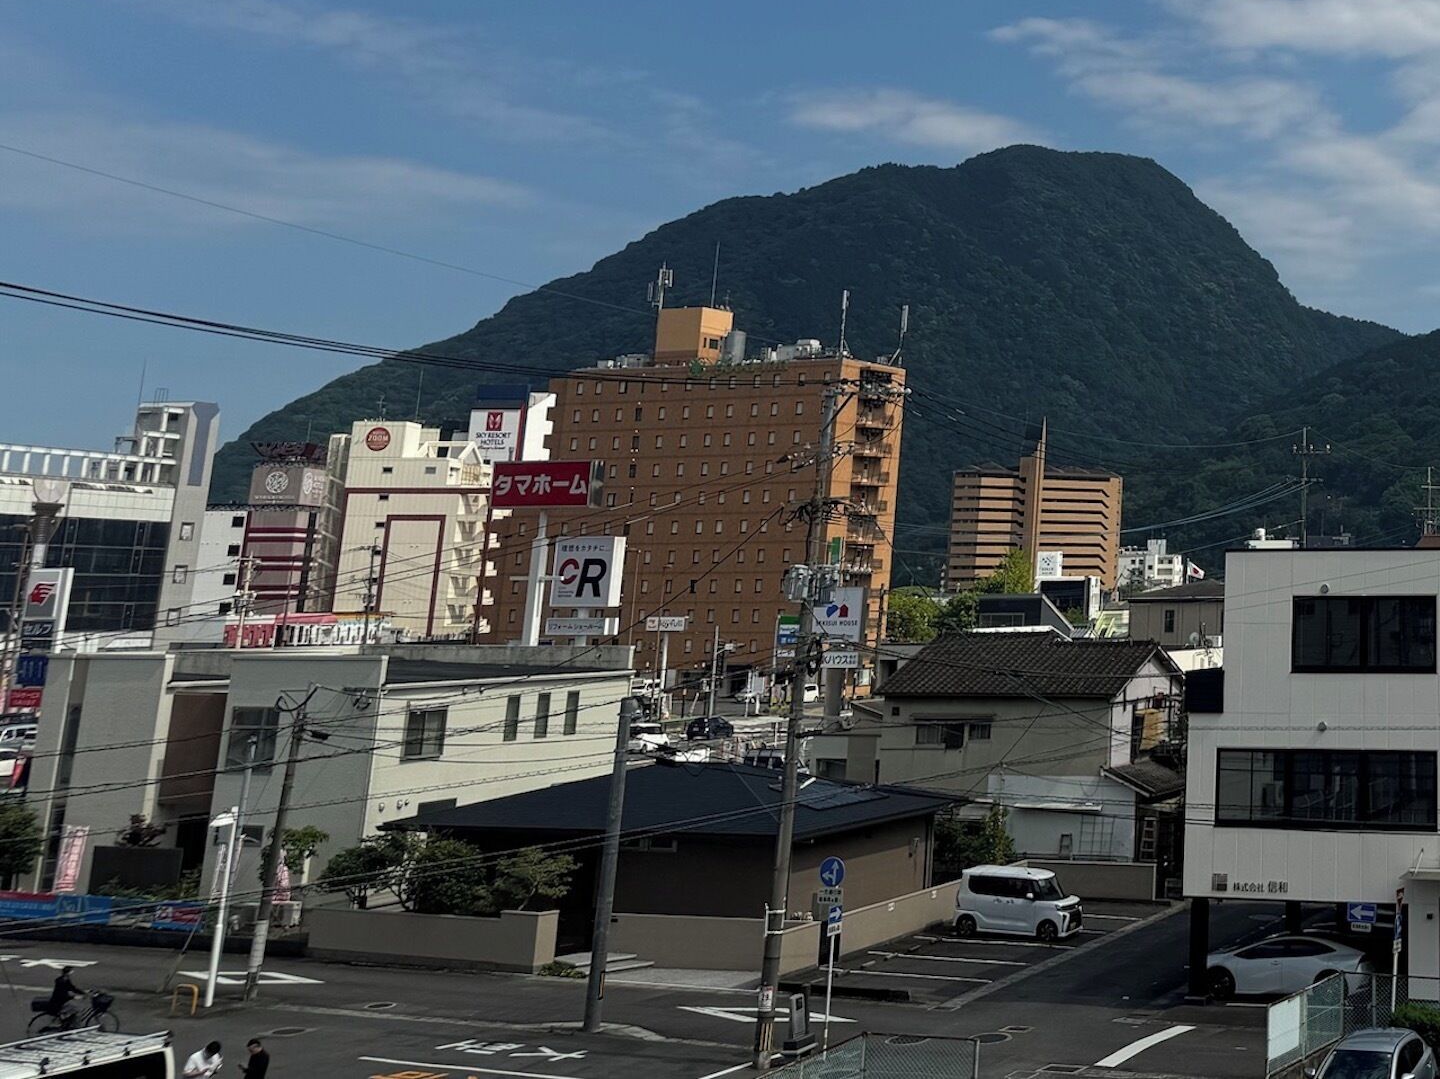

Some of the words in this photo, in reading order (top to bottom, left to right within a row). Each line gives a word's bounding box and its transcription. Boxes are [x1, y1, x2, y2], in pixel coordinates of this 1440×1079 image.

[494, 473, 588, 496] タマホーム
[23, 623, 53, 636] セルフ
[1233, 881, 1265, 893] 株式会社
[1268, 880, 1289, 893] 信和
